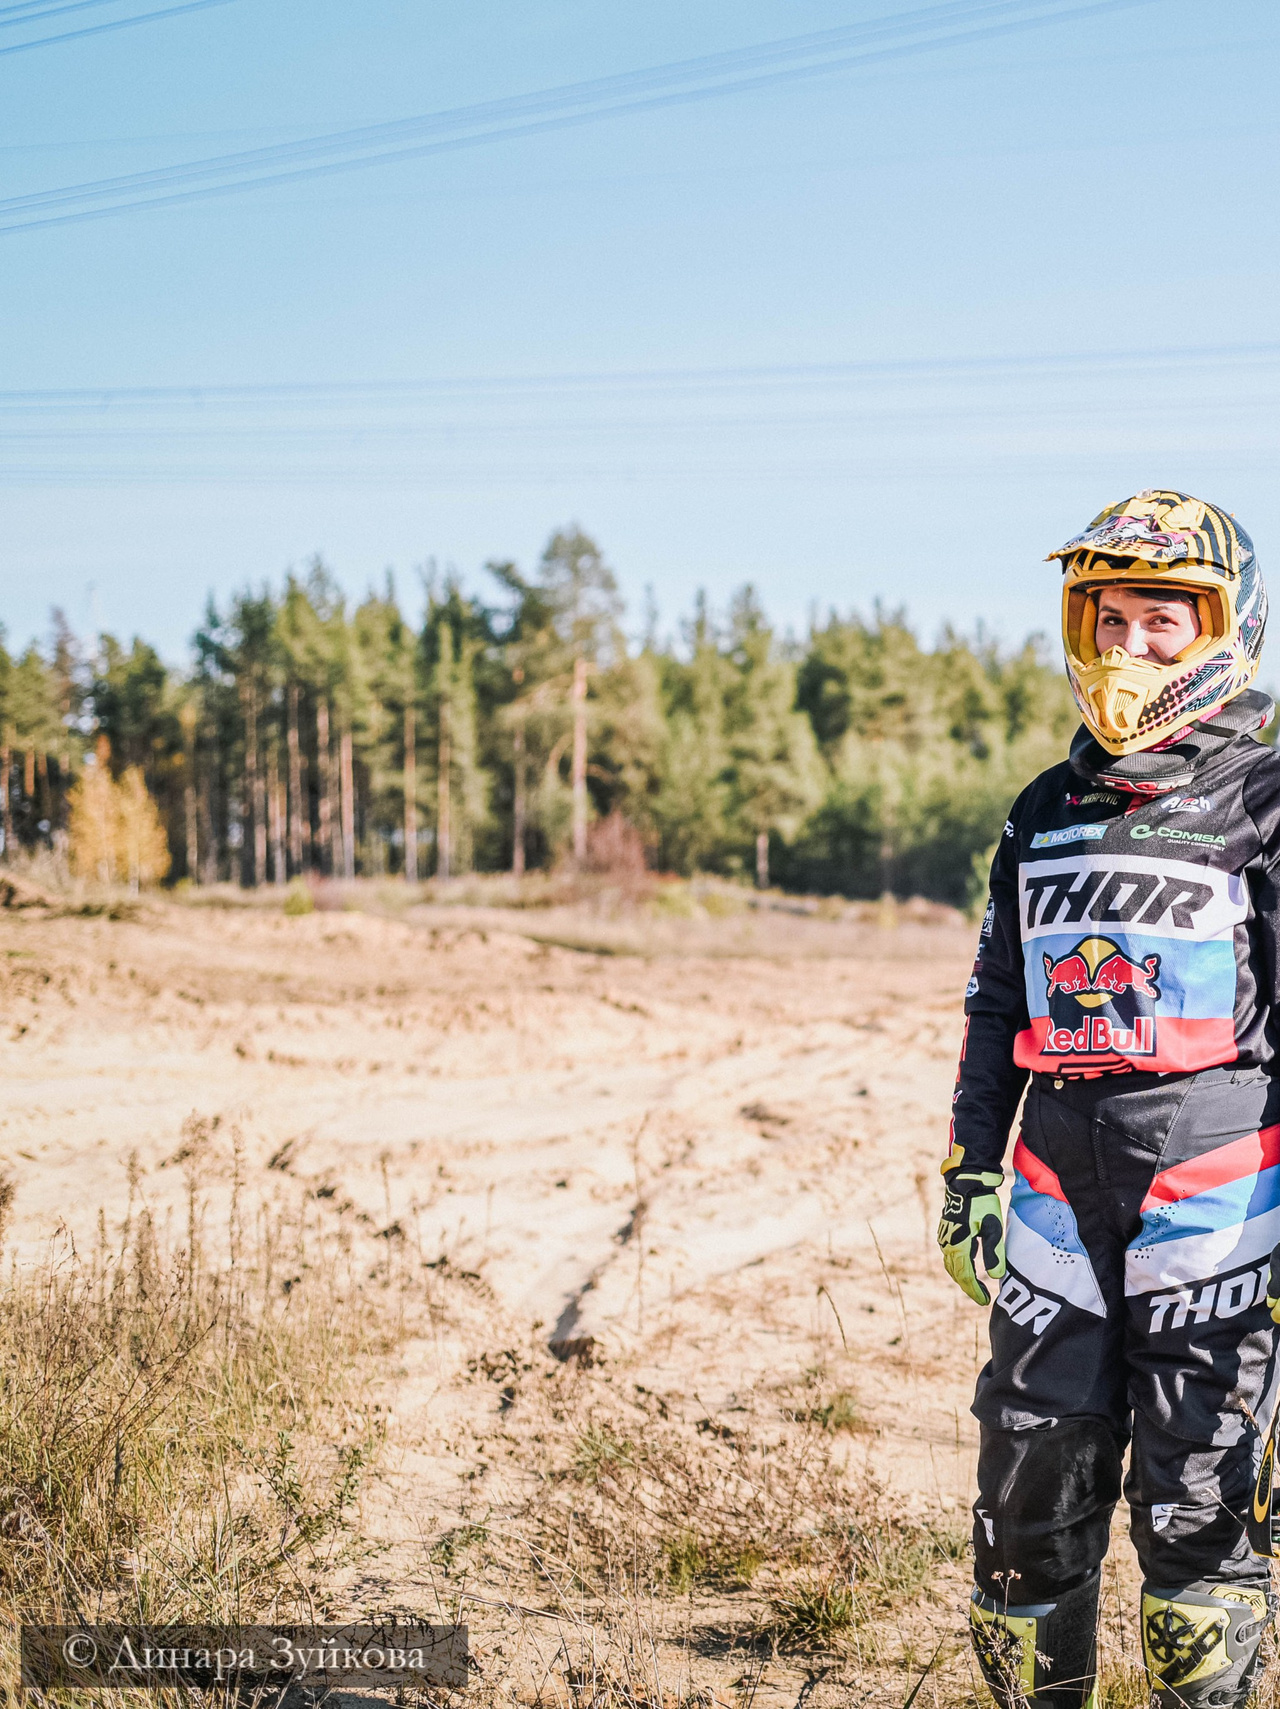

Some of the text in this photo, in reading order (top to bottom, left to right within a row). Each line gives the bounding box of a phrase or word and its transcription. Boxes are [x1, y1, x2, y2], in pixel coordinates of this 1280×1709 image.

[1051, 826, 1104, 843] MOTOREX
[1156, 826, 1226, 846] COMISA
[1025, 871, 1215, 930] THOR
[1091, 1016, 1154, 1053] Bull
[996, 1269, 1062, 1336] OR
